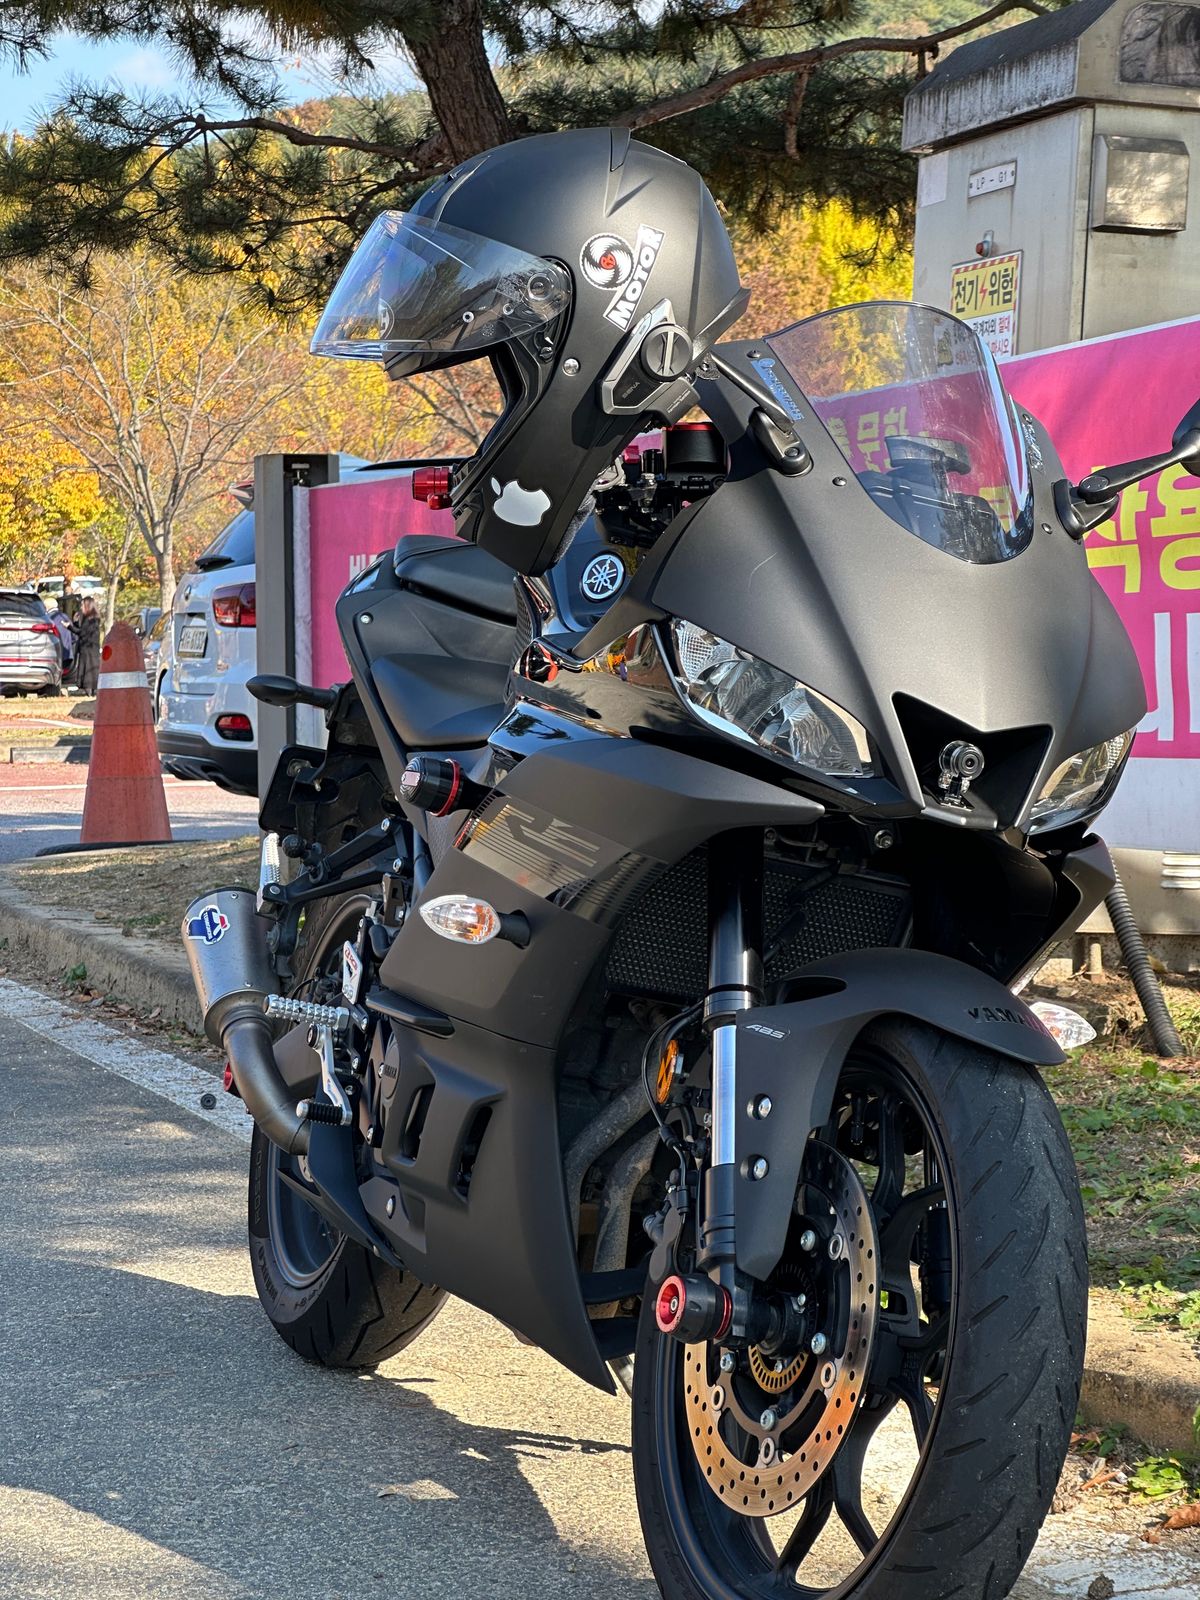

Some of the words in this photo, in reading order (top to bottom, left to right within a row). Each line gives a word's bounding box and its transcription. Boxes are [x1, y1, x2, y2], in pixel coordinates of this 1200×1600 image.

[606, 226, 664, 330] MOTOR
[954, 275, 979, 313] 전기
[988, 266, 1015, 306] 위험
[745, 1024, 786, 1039] ABS
